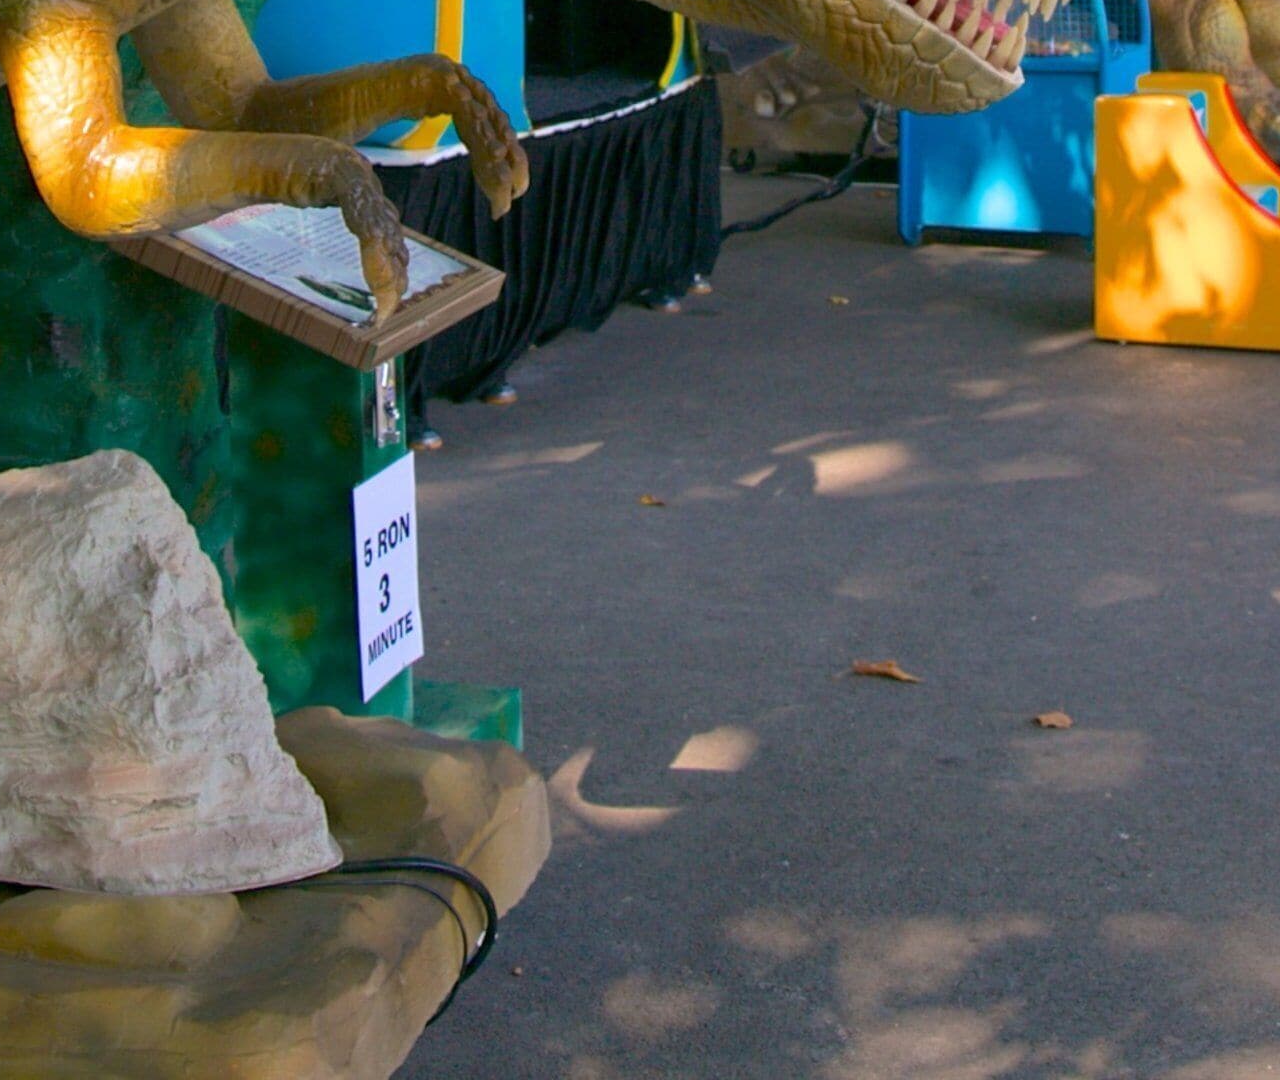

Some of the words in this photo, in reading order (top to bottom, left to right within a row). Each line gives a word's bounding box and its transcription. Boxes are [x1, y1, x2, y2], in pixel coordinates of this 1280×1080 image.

[363, 537, 373, 567] 5
[377, 513, 410, 558] RON
[379, 573, 391, 612] 3
[367, 611, 413, 664] MINUTE
